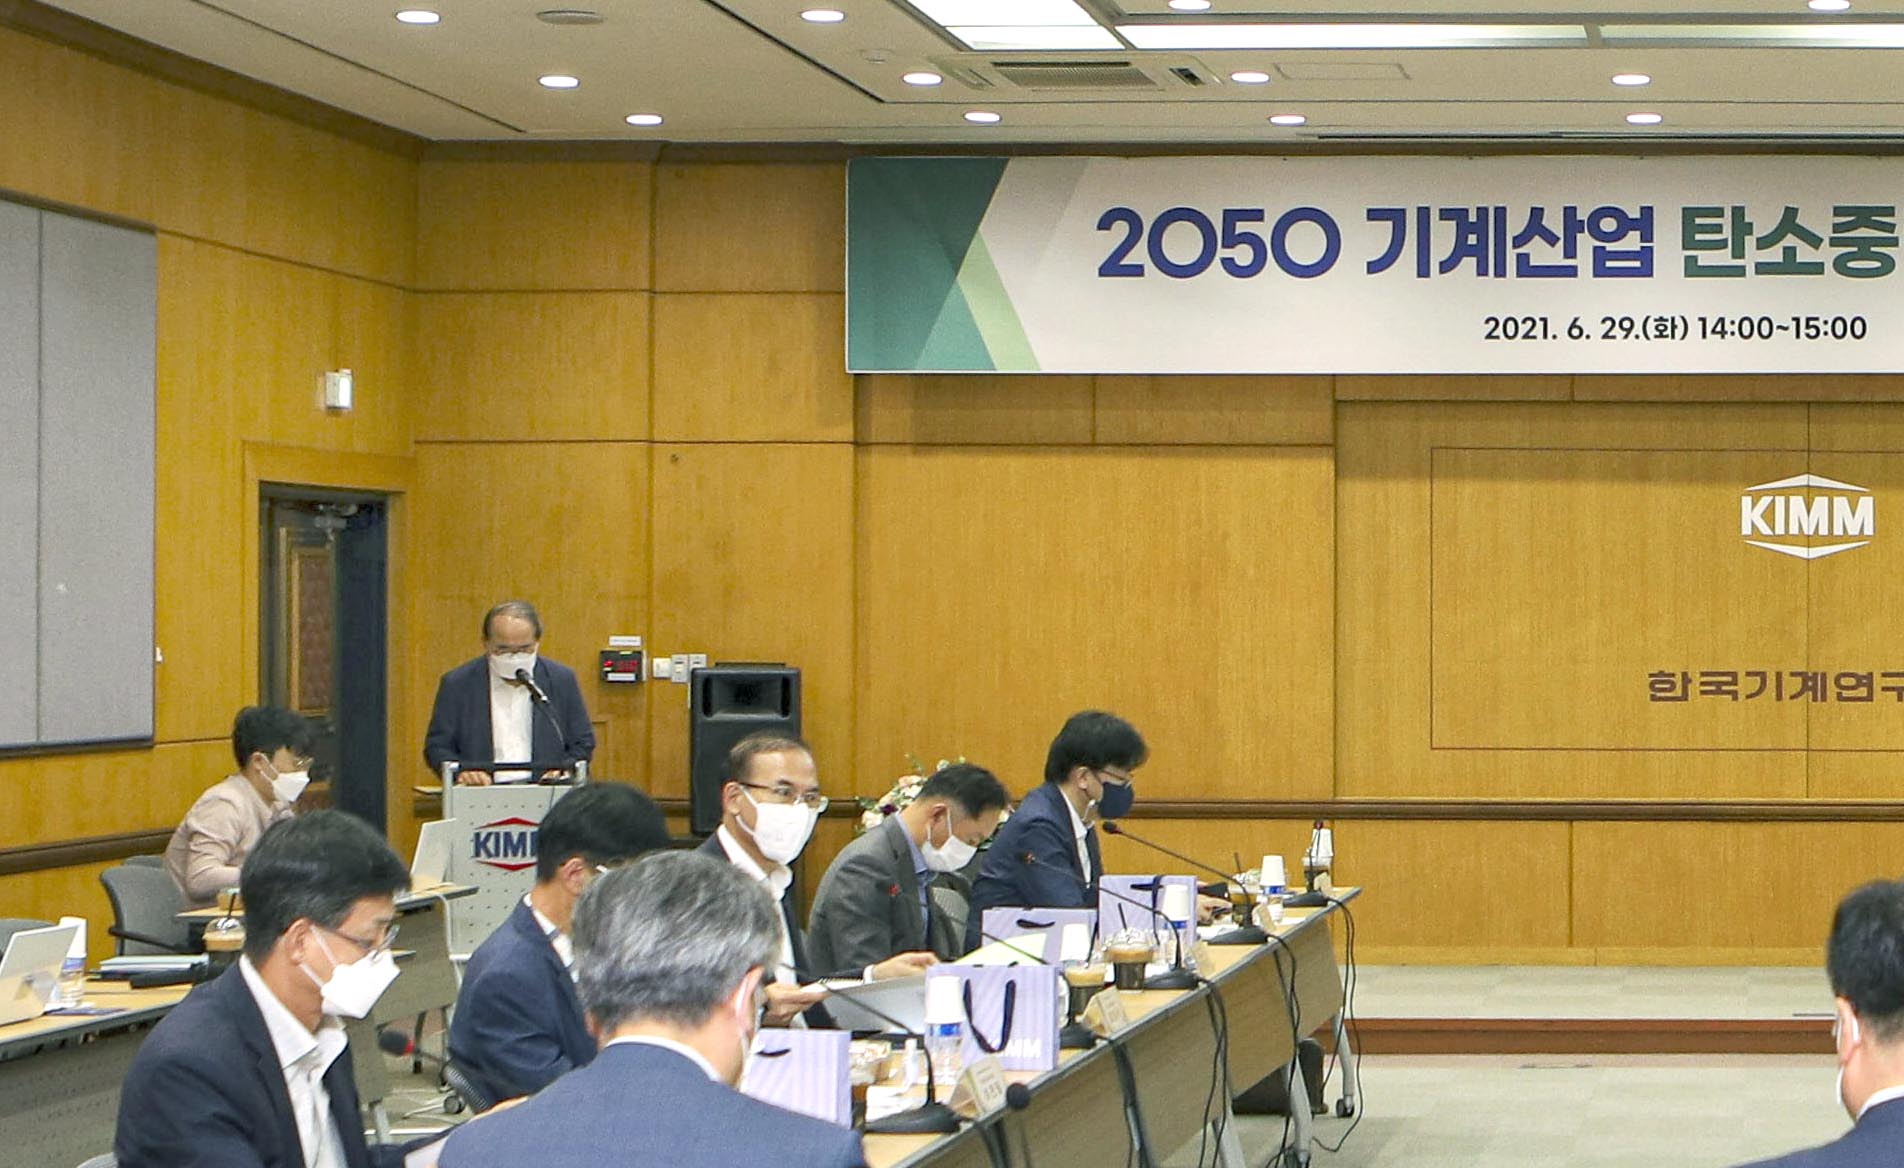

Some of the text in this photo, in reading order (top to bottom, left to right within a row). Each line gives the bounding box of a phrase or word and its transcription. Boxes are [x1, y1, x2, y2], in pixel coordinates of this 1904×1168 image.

[1096, 205, 1342, 280] 2050
[1365, 205, 1656, 280] 기계산업
[1484, 315, 1867, 341] 2021. 6. 29.(화) 14:00~15:00
[1741, 496, 1875, 536] KIMM
